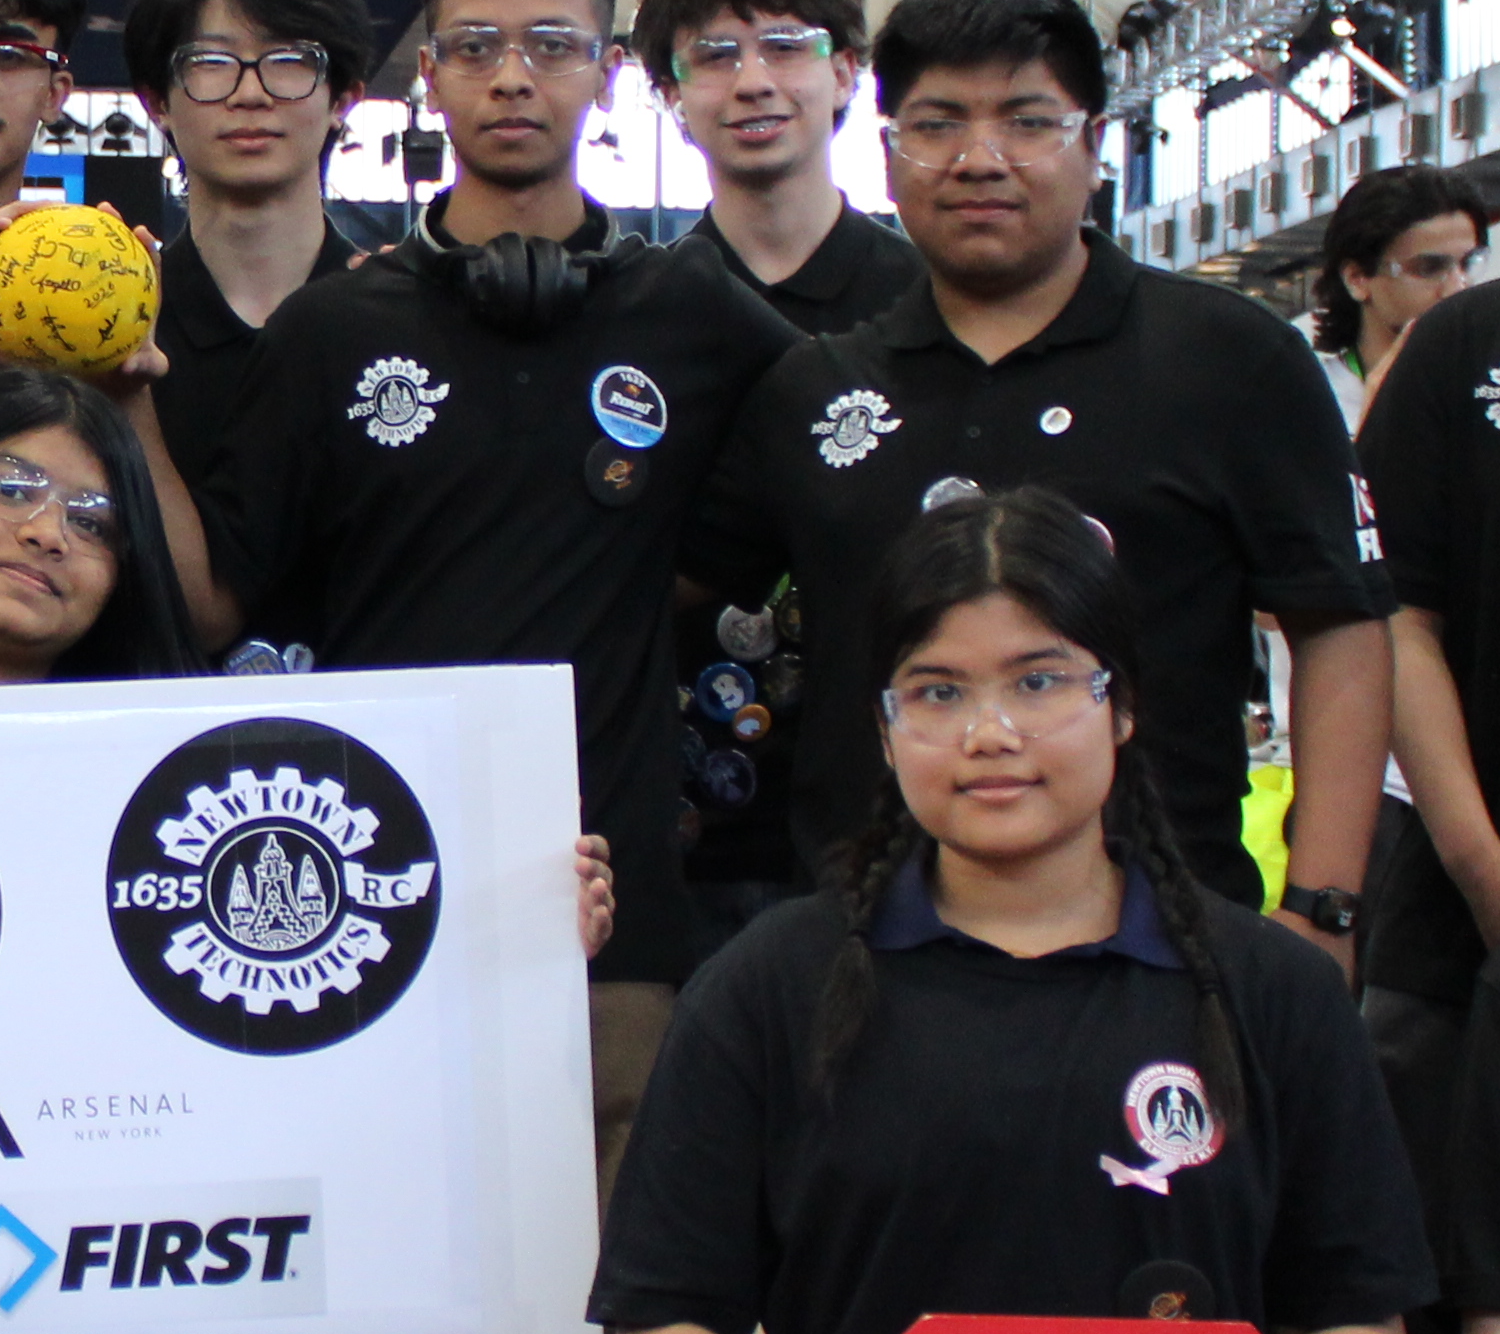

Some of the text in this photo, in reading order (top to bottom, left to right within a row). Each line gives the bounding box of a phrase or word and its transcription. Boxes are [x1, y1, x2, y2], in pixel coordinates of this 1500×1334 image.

[346, 399, 375, 420] 1635
[174, 785, 367, 859] NEWTOWN
[112, 873, 205, 912] 1635
[183, 921, 372, 993] TECHNOTICS
[36, 1091, 196, 1122] ARSENAL
[74, 1126, 163, 1142] NEW YORK
[59, 1214, 312, 1293] FIRST
